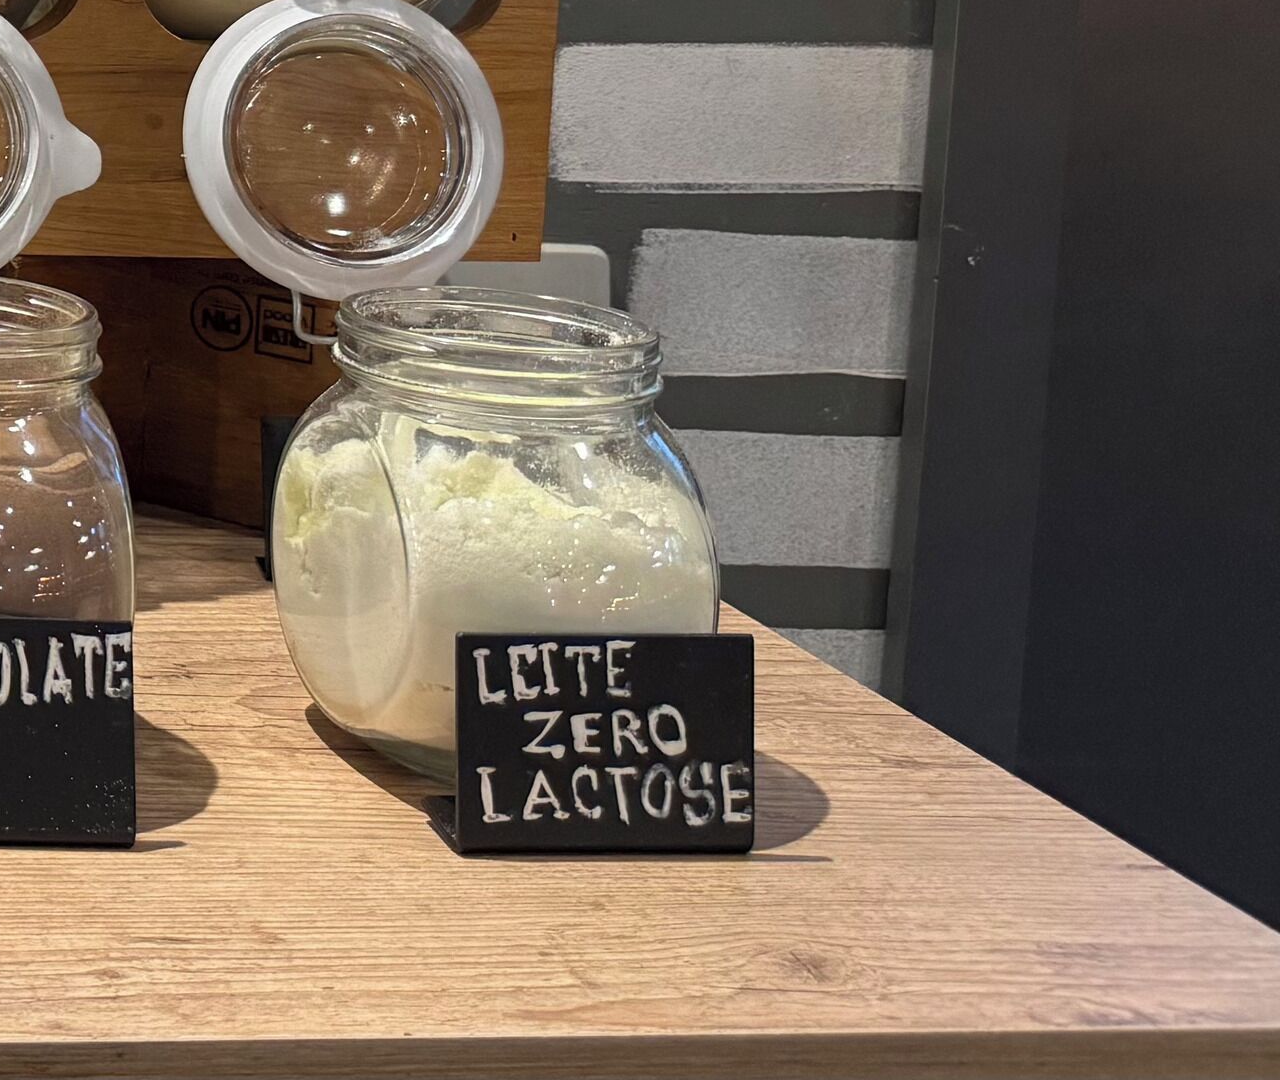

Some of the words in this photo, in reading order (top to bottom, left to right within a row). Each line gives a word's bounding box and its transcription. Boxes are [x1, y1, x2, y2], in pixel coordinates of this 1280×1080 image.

[472, 640, 637, 705] LEITE
[522, 703, 688, 760] ZERO
[475, 760, 752, 826] LACTOSE
